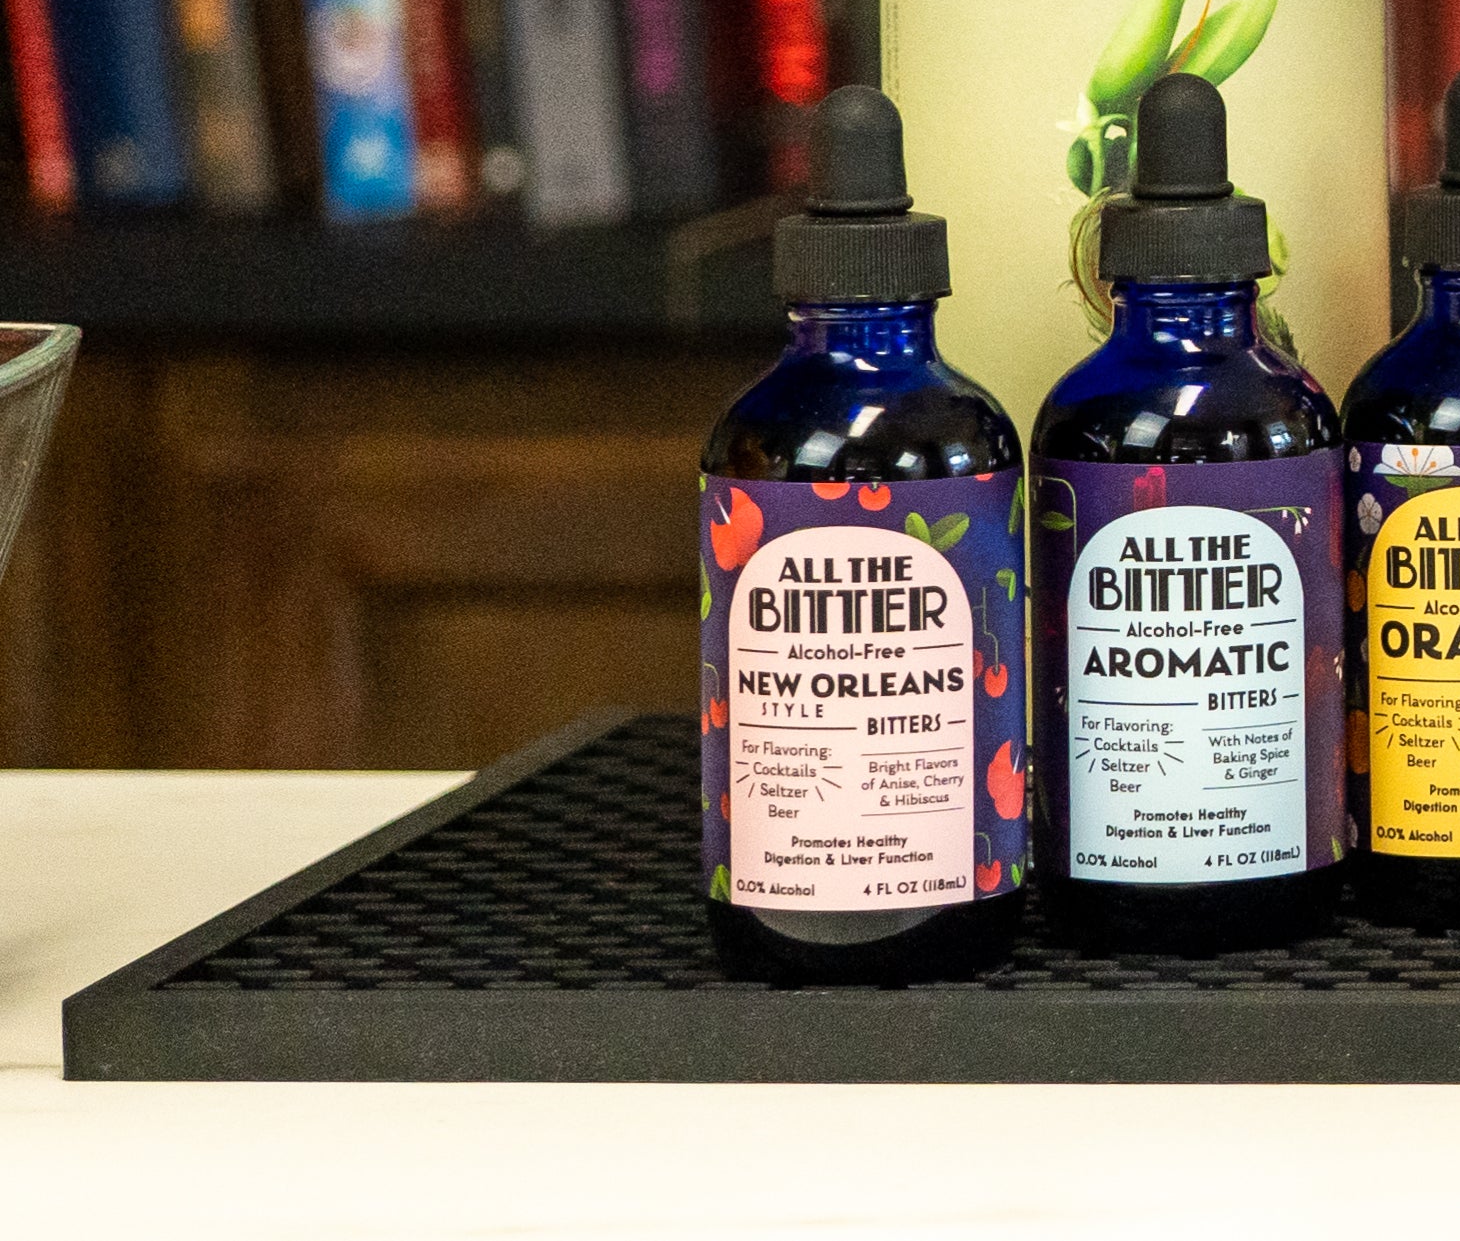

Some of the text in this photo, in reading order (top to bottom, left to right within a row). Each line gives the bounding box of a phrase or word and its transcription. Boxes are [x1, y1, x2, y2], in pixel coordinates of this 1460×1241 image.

[1119, 534, 1251, 563] ALL THE
[778, 556, 913, 583] ALL THE
[1089, 564, 1282, 612] BITTER
[749, 587, 948, 633] BITTER
[1126, 621, 1244, 637] Alcohol-Free
[788, 644, 906, 660] Alcohol-Free
[1083, 641, 1289, 678] AROMATIC
[738, 667, 964, 698] NEW ORLEANS
[1209, 689, 1278, 711] BITTERS
[1381, 693, 1399, 706] For
[762, 703, 824, 718] STYLE
[868, 714, 941, 735] BITTERS
[1082, 716, 1173, 734] For Flavoring:
[1392, 714, 1453, 728] Cocktails
[1094, 737, 1159, 752] Cocktails
[1208, 729, 1292, 747] With Notes of
[1399, 734, 1445, 748] Seltzer
[742, 740, 832, 759] For Flavoring:
[1213, 748, 1289, 765] Baking Spice
[753, 762, 816, 778] Cocktails
[869, 757, 959, 775] Bright Flavors
[1101, 758, 1150, 773] Seltzer
[1407, 755, 1436, 769] Beer
[862, 773, 964, 791] of Anise, Cherry
[1225, 766, 1278, 781] & Ginger
[760, 783, 809, 800] Seltzer
[1110, 780, 1141, 793] Beer
[880, 792, 950, 807] & Hibiscus
[1403, 800, 1459, 814] Digestion
[769, 805, 799, 819] Beer
[1134, 807, 1246, 822] Promotes Healthy
[1106, 822, 1271, 840] Digestion & Liver Function
[1376, 827, 1453, 842] 0.0% Alcohol
[792, 834, 907, 850] Promotes Healthy
[764, 850, 934, 868] Digestion & Liver Function
[1076, 853, 1157, 868] 0.0% Alcohol
[1205, 846, 1300, 867] 4 FL OZ (118mL)
[737, 878, 814, 896] 0.0% Alcohol
[864, 876, 967, 896] 4 FL OZ (118mL)
